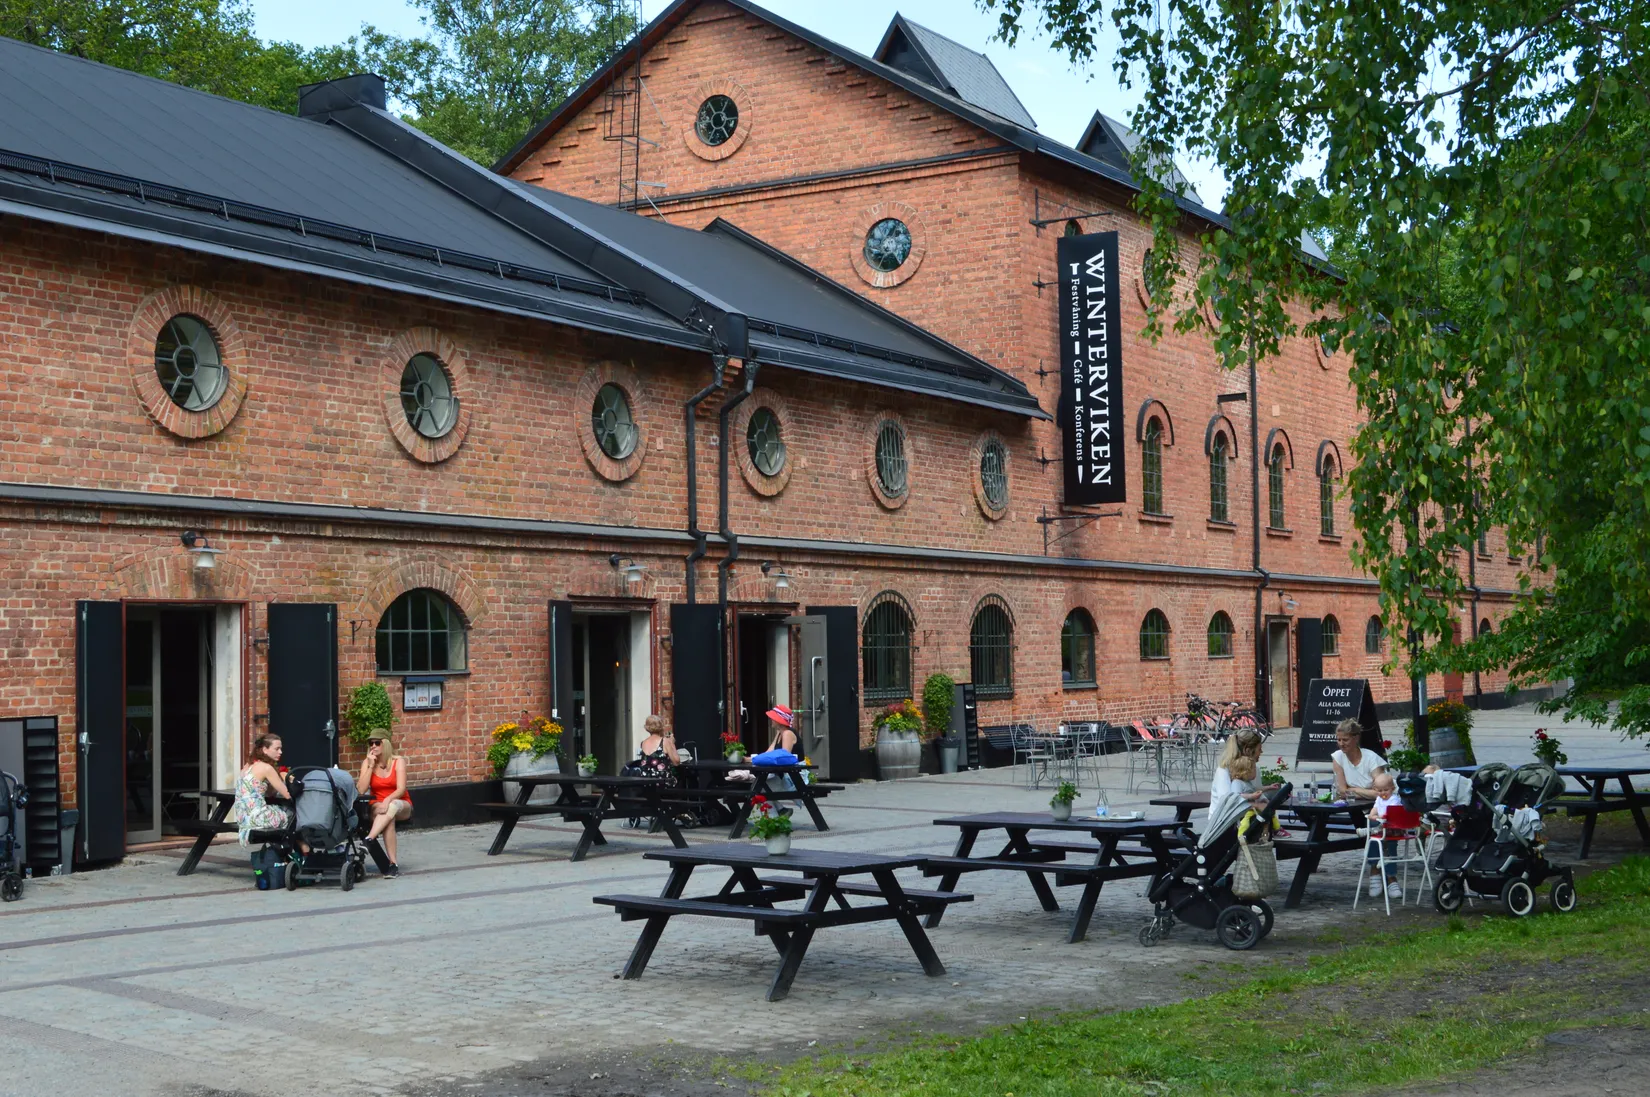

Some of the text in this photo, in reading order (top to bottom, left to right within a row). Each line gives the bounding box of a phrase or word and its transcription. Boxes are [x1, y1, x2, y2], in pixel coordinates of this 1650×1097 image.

[1070, 278, 1085, 461] Festvåning Café Konferens
[1085, 249, 1111, 485] WINTERVIKEN
[1322, 686, 1351, 696] ÖPPET
